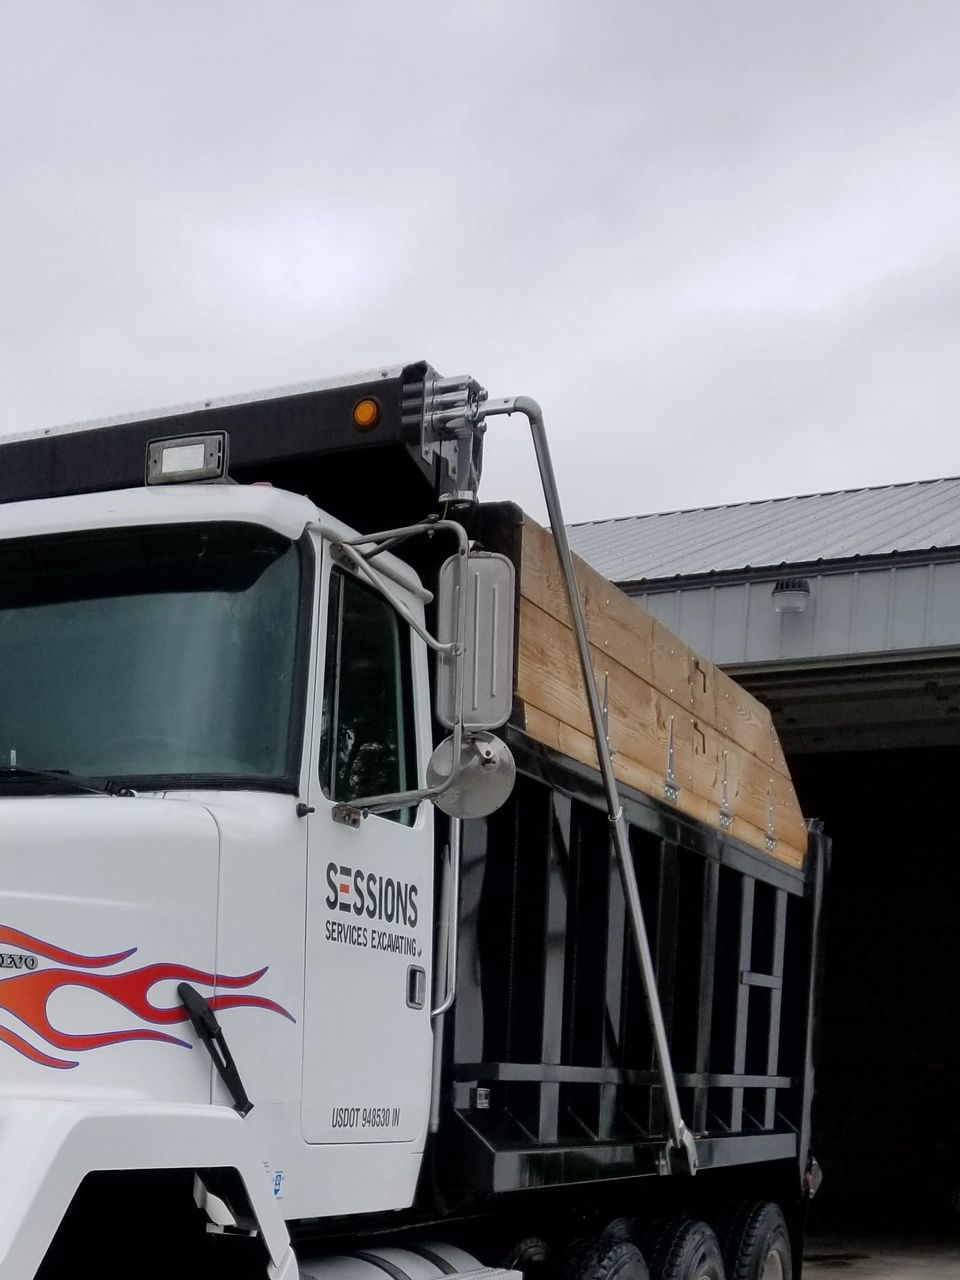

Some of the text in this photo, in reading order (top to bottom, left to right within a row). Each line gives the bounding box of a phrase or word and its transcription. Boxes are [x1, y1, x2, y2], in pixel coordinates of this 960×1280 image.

[325, 862, 418, 928] SESSIONS
[325, 919, 416, 957] SERVICES EXCAVATING
[331, 1107, 400, 1128] USDOT 948530 IN
